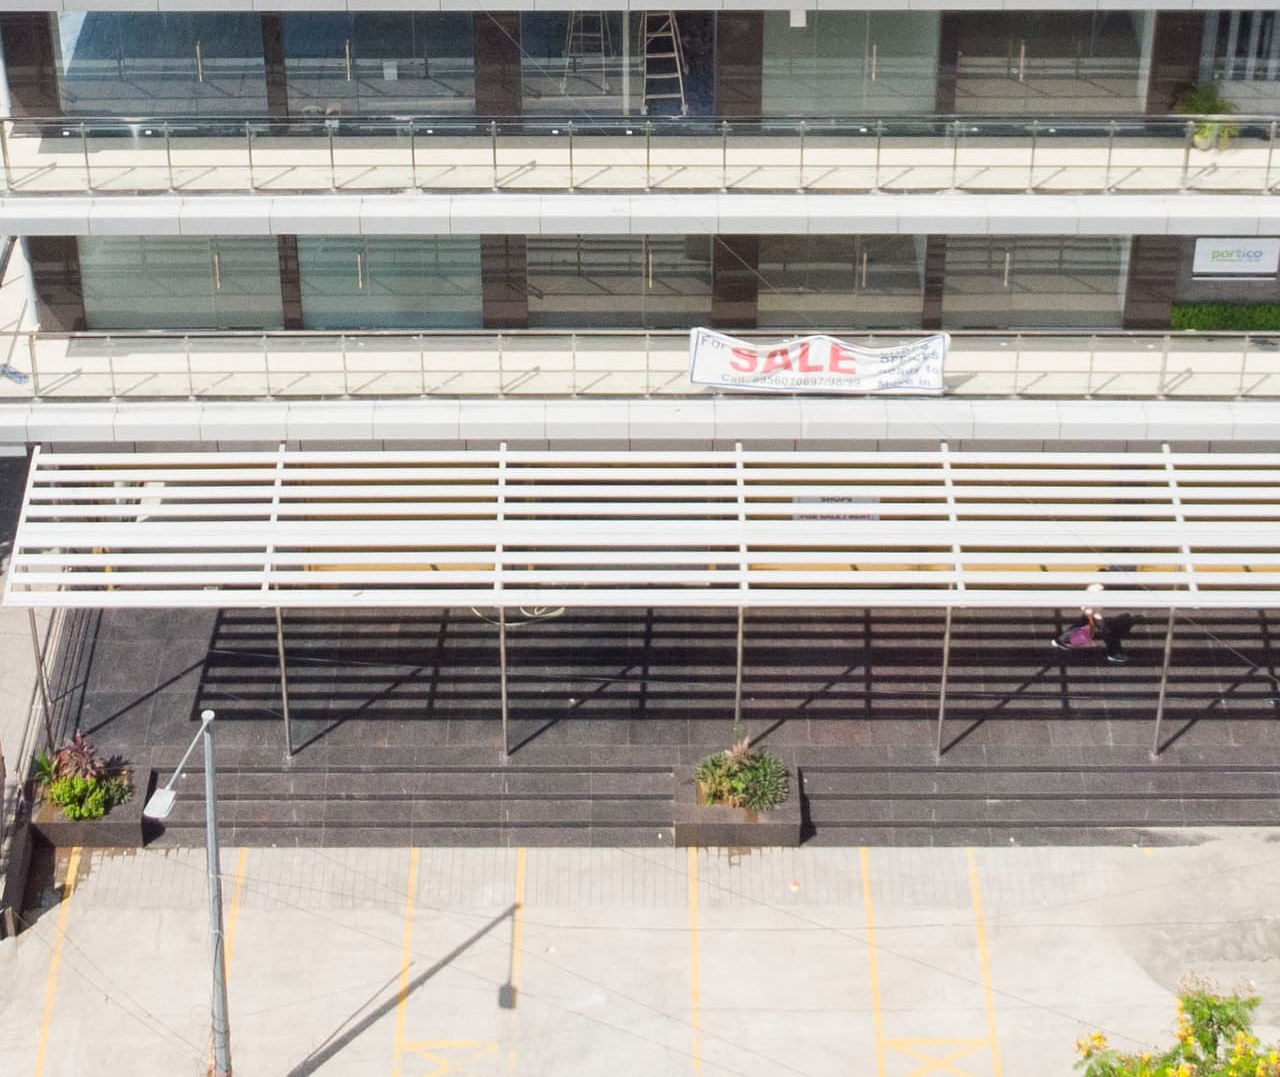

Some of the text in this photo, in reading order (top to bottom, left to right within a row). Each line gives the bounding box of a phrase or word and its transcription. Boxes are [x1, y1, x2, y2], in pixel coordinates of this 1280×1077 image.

[1211, 249, 1263, 260] portico
[701, 335, 727, 349] For
[729, 342, 857, 374] SALE
